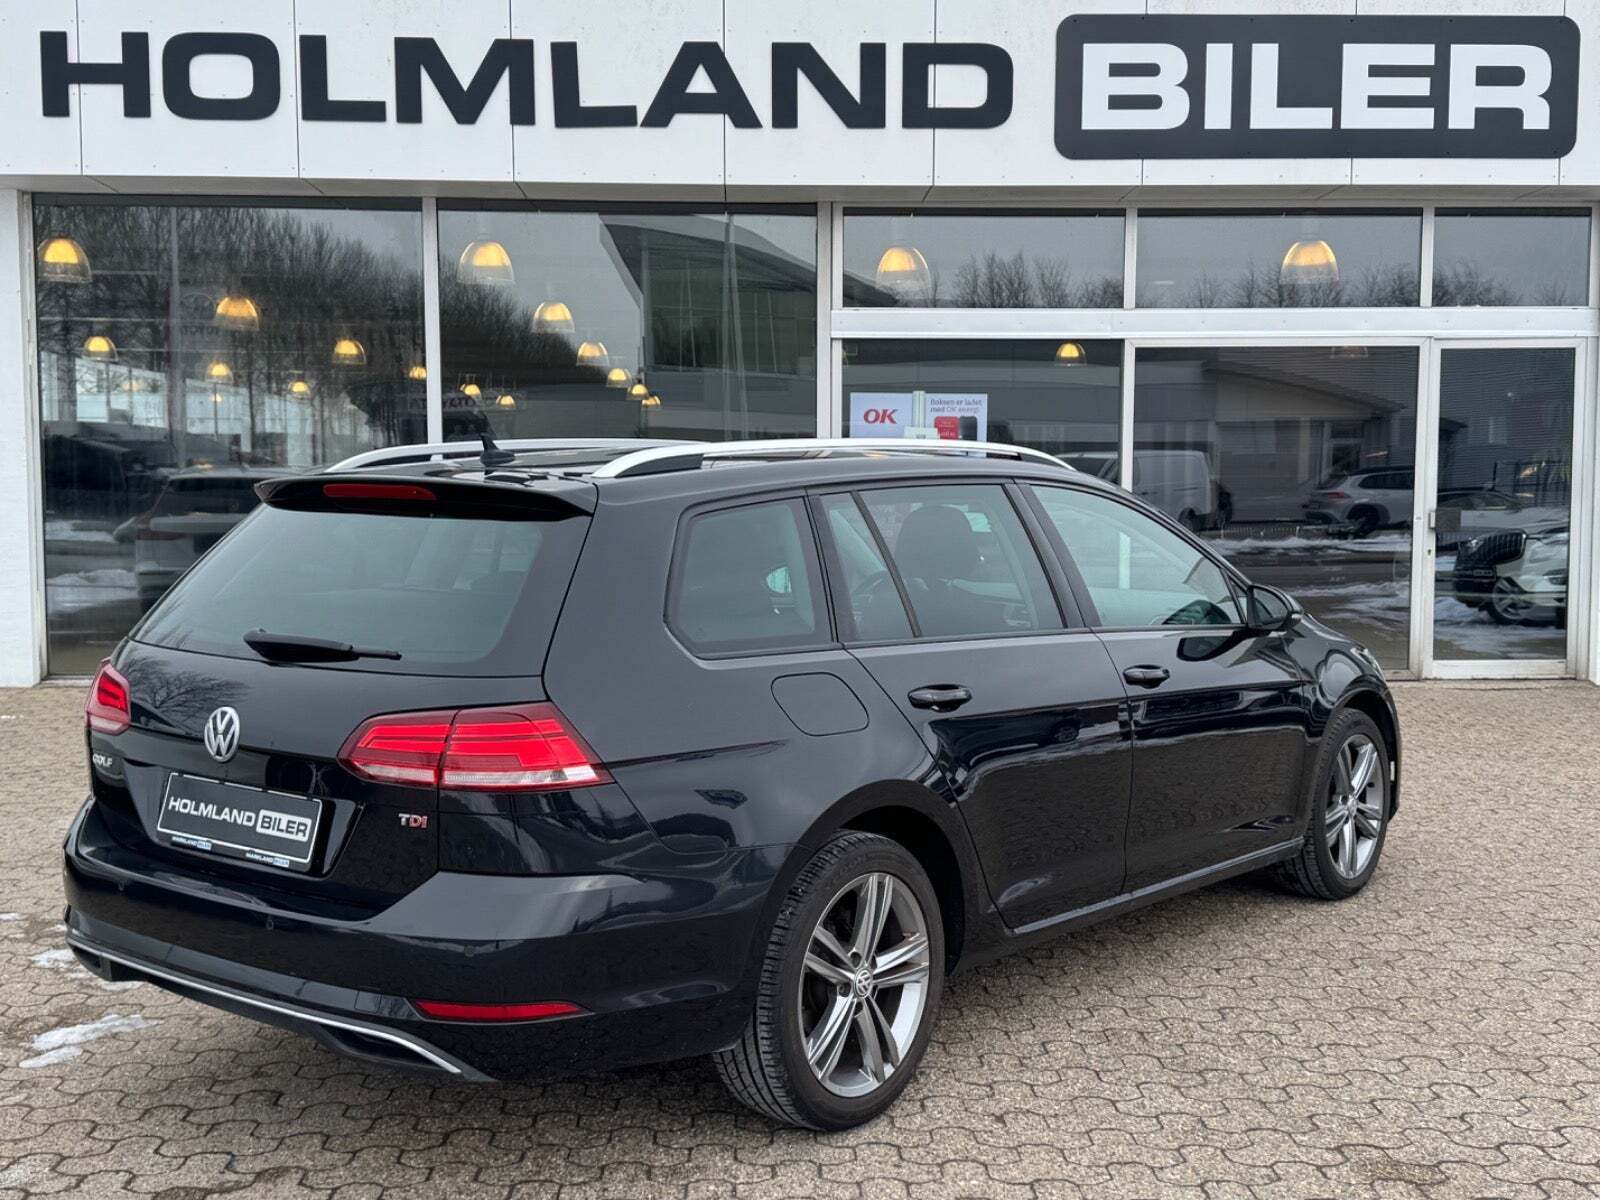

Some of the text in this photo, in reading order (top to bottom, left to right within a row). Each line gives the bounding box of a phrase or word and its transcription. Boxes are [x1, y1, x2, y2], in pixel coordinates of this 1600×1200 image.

[40, 30, 1553, 130] HOLMLAND BILER
[863, 408, 898, 424] OK
[93, 753, 112, 767] GOLF
[168, 796, 309, 837] HOLMLAND BILER
[398, 813, 428, 828] TDI
